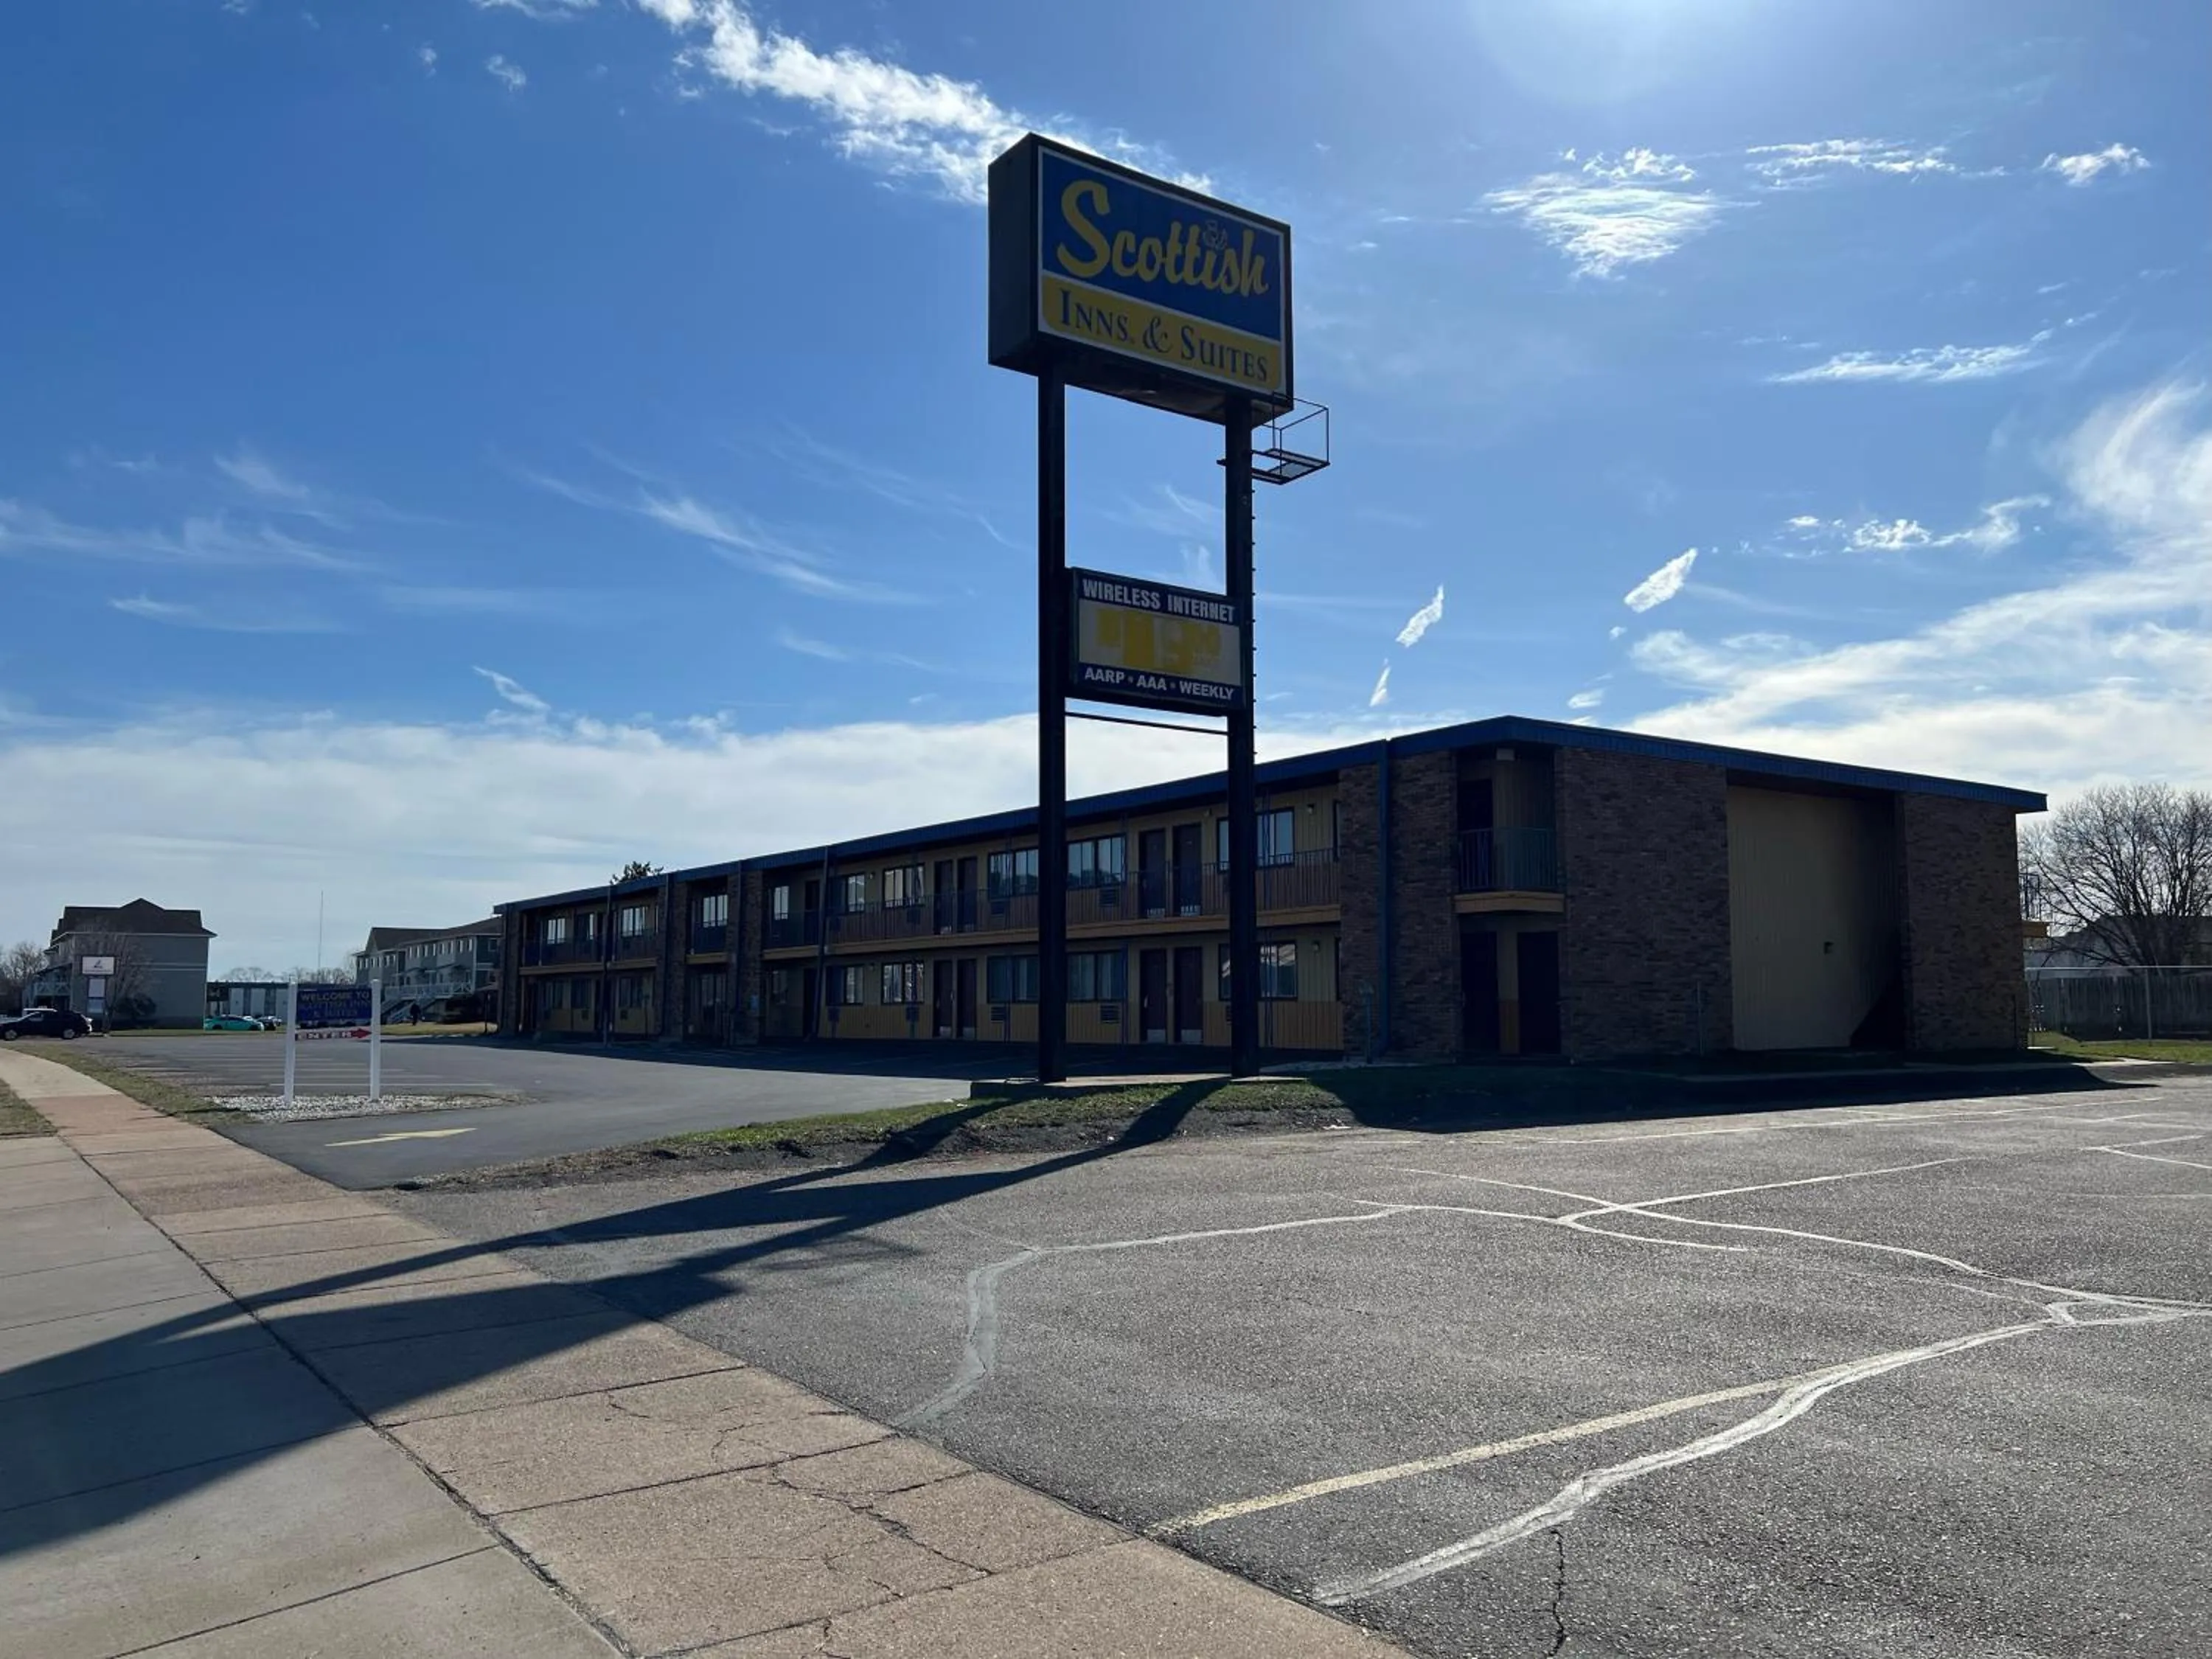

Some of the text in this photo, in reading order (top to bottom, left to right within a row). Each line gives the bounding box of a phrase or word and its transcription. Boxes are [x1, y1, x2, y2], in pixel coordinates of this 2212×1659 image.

[1057, 180, 1268, 296] Scottish
[1143, 316, 1173, 353] &
[1180, 325, 1268, 382] SUITES
[1082, 579, 1235, 623] WIRELESS INTERNET
[1085, 667, 1234, 700] AARP AAA WEEKLY
[300, 991, 369, 1001] WELCOME TO
